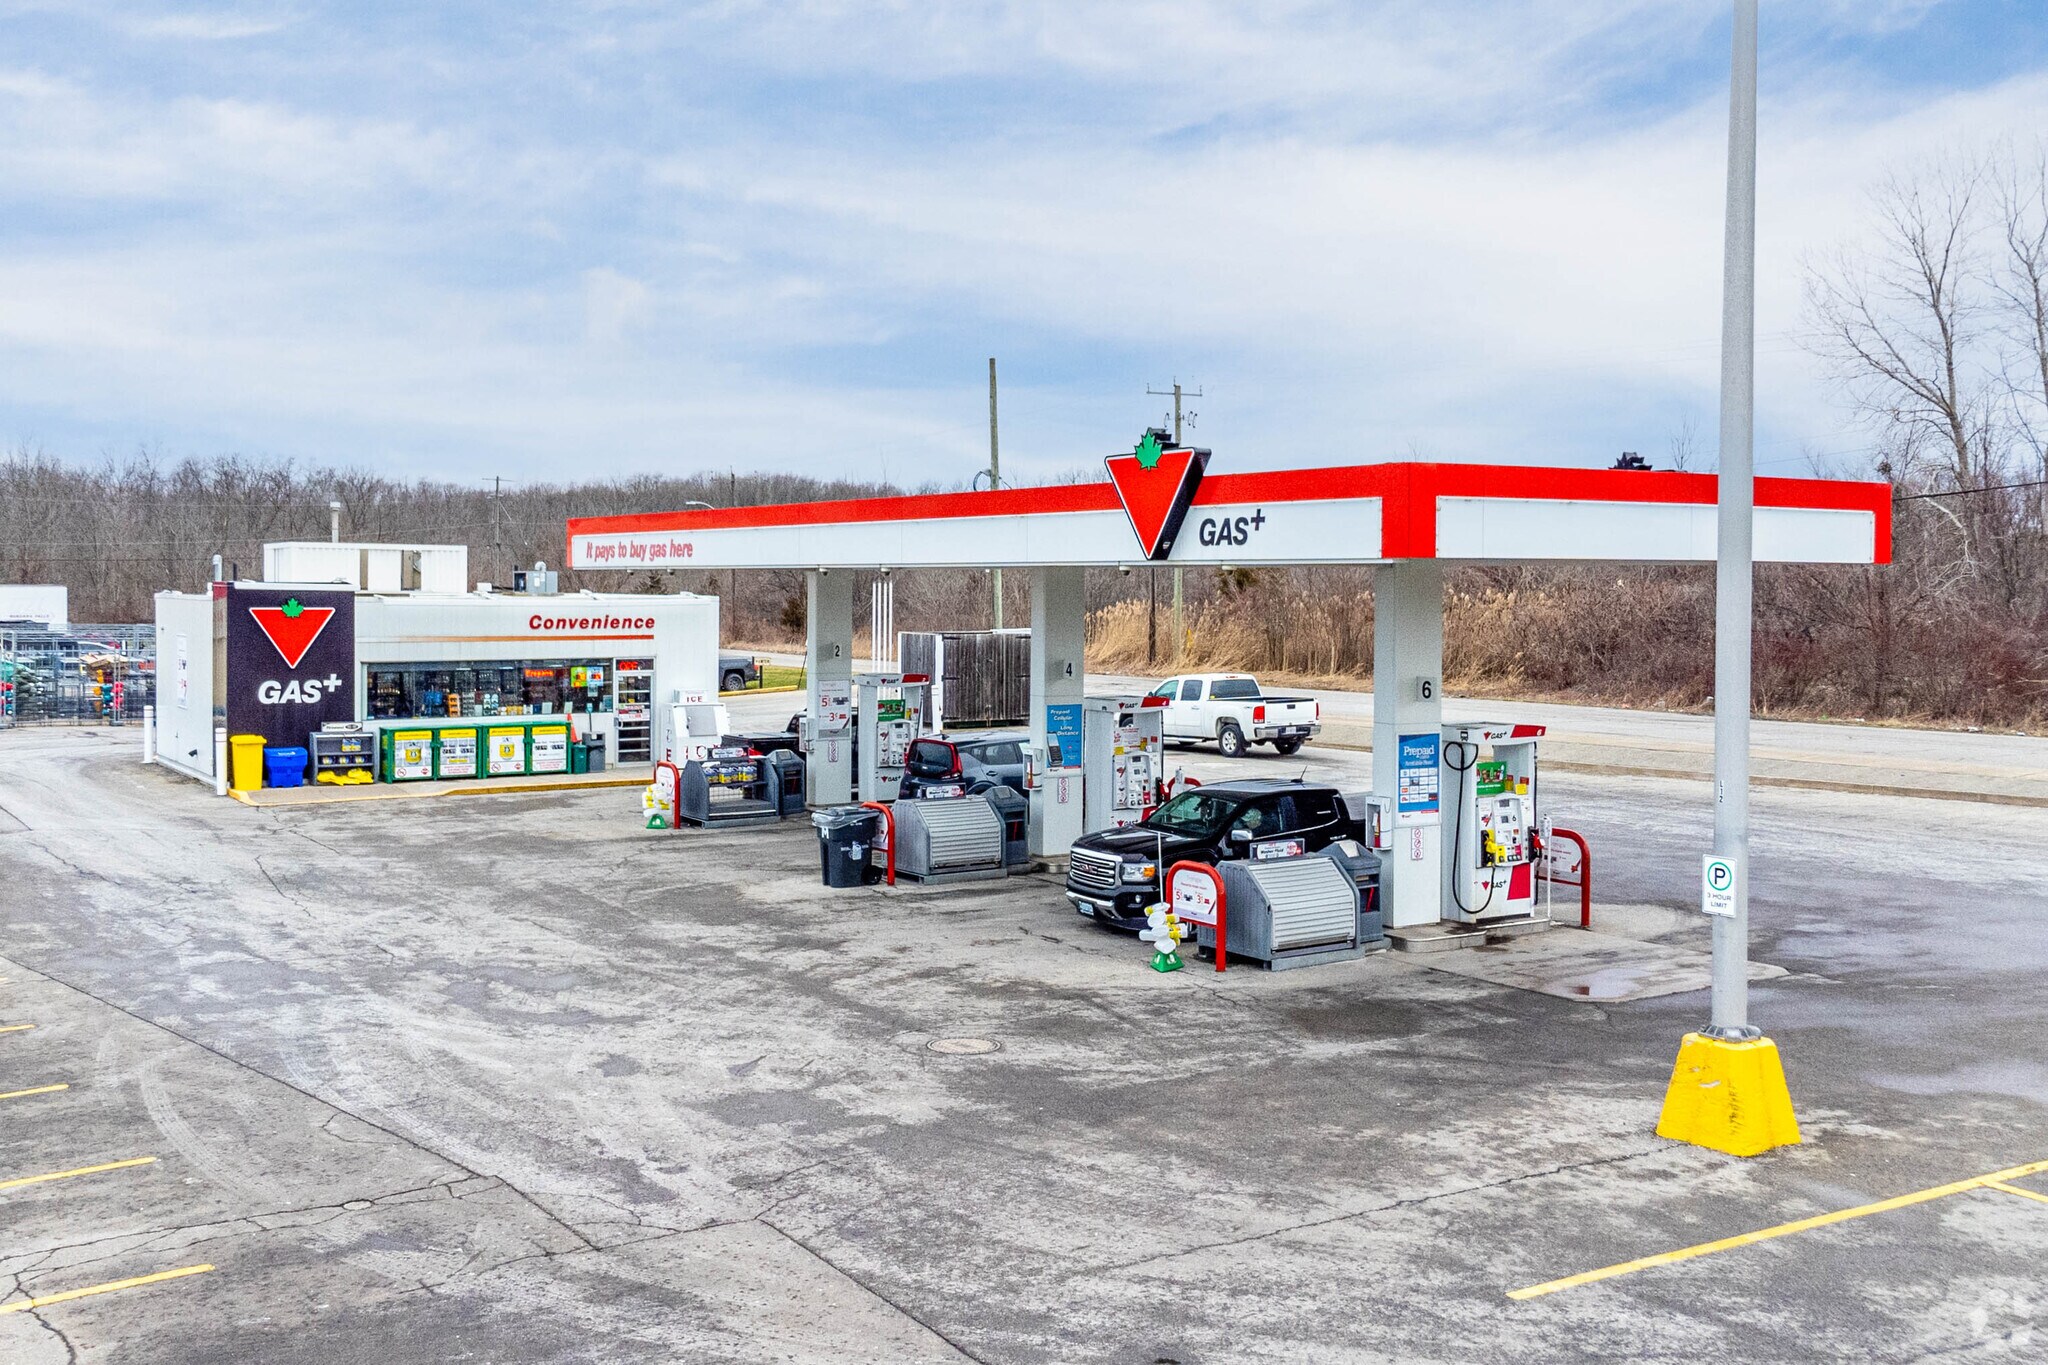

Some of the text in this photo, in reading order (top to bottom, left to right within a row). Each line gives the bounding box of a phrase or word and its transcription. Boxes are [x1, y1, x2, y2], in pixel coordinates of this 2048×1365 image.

[1200, 509, 1265, 546] GAS+
[586, 539, 693, 562] It pays to buy gas here
[529, 615, 655, 629] Convenience
[835, 645, 840, 657] 2
[1065, 663, 1073, 676] 4
[258, 674, 342, 704] GAS+
[1422, 681, 1432, 698] 6
[1536, 728, 1542, 736] 6
[1403, 745, 1434, 758] Prepaid
[821, 827, 829, 839] M
[1714, 867, 1726, 884] P
[1713, 894, 1732, 902] HOUR
